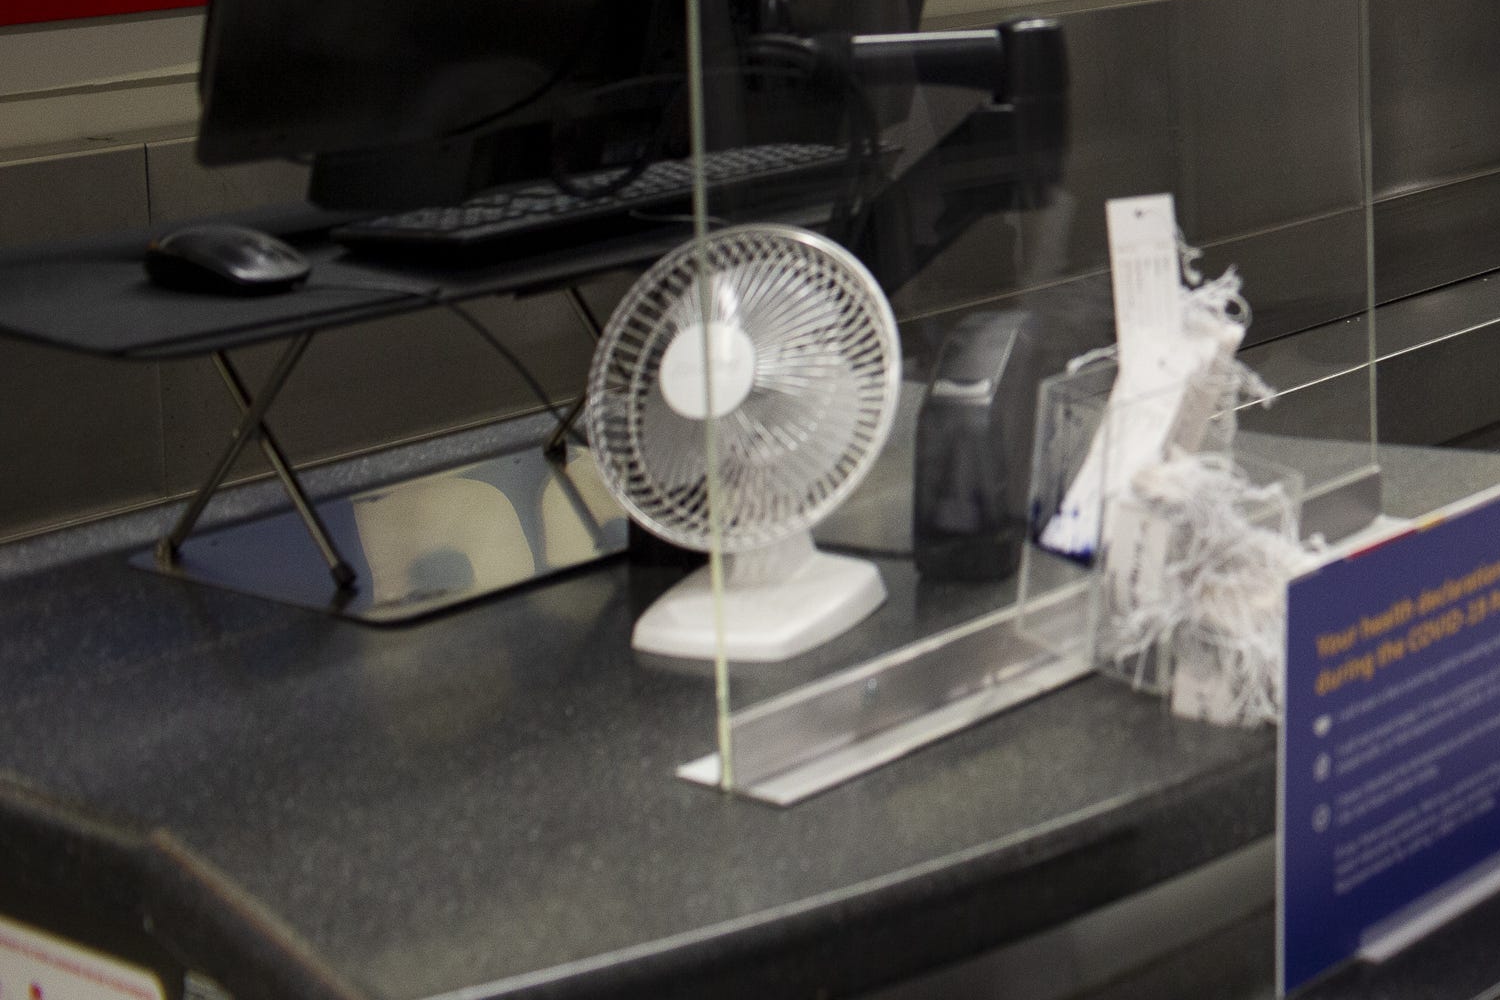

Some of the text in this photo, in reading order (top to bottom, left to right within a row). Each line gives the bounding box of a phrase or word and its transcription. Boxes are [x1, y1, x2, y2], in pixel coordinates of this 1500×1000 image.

[1315, 626, 1358, 658] Your
[1359, 599, 1413, 638] health
[1314, 653, 1375, 696] during
[1376, 640, 1405, 667] the
